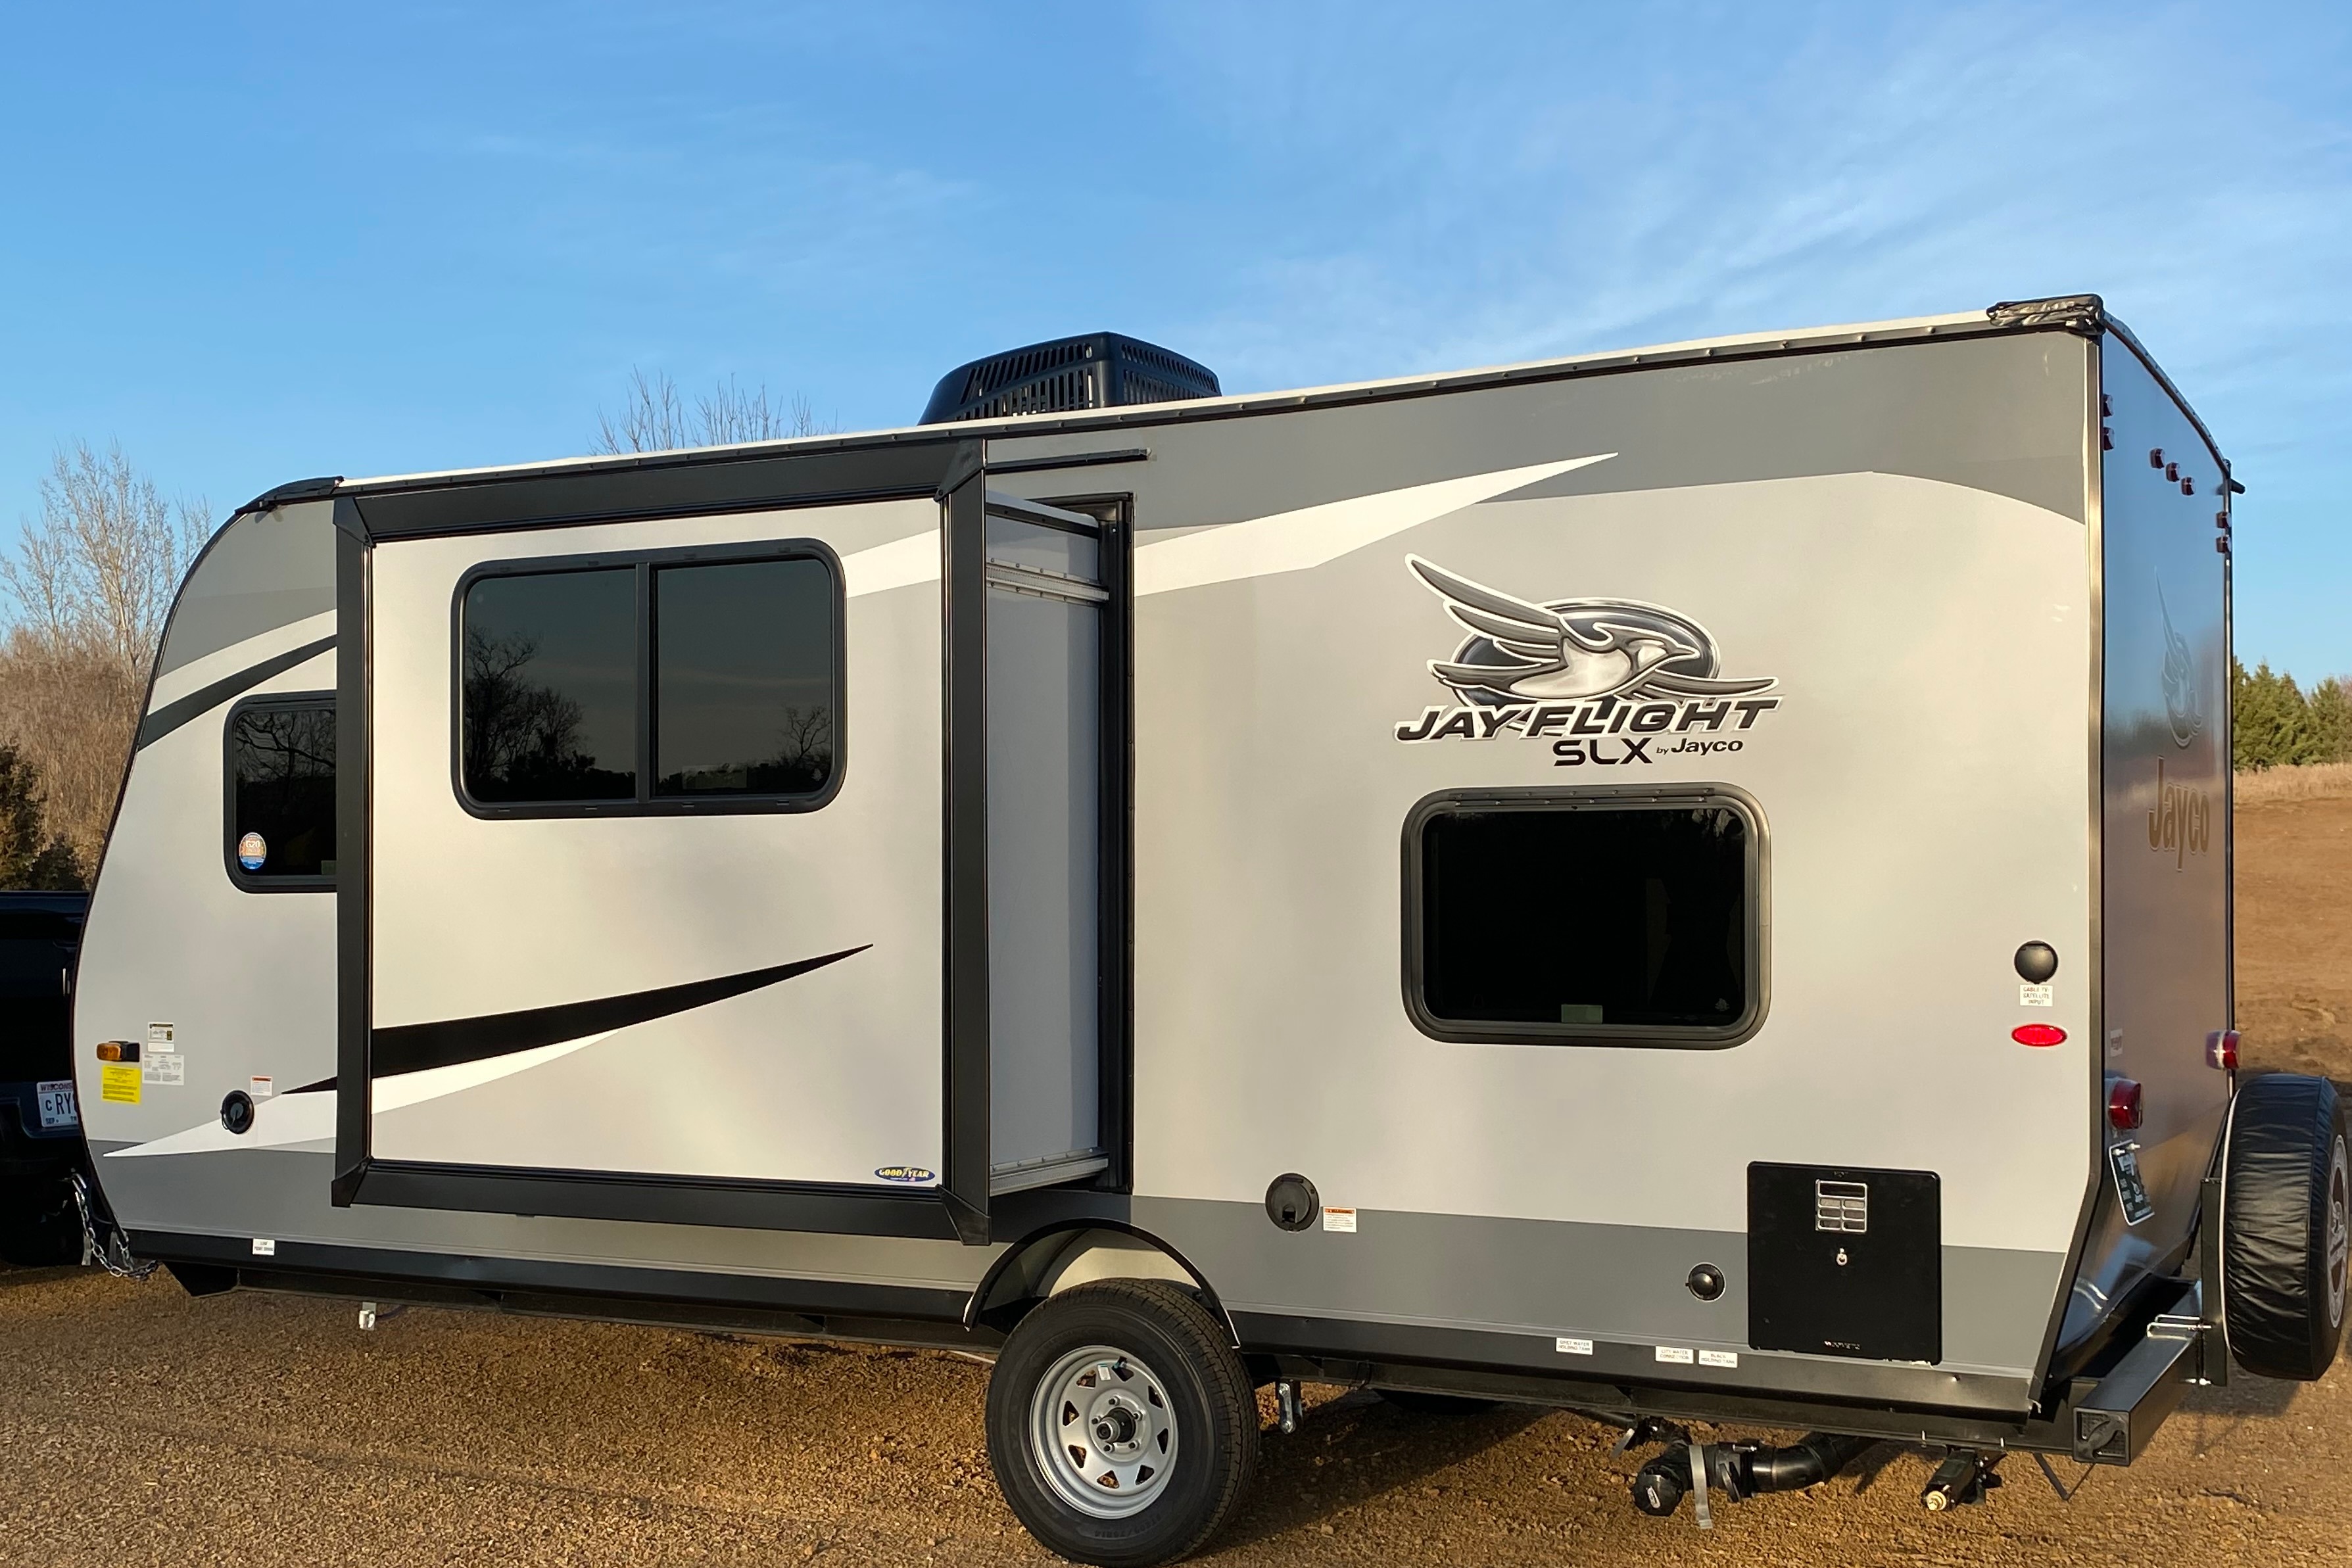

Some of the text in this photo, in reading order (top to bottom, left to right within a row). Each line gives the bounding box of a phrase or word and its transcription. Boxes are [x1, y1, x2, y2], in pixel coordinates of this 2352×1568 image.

[1397, 699, 1779, 741] JAY FLIGHT
[1552, 737, 1743, 767] SLX by Jayco
[2148, 755, 2210, 872] Jayco
[40, 1083, 73, 1091] WISCONS
[55, 1093, 78, 1114] RY
